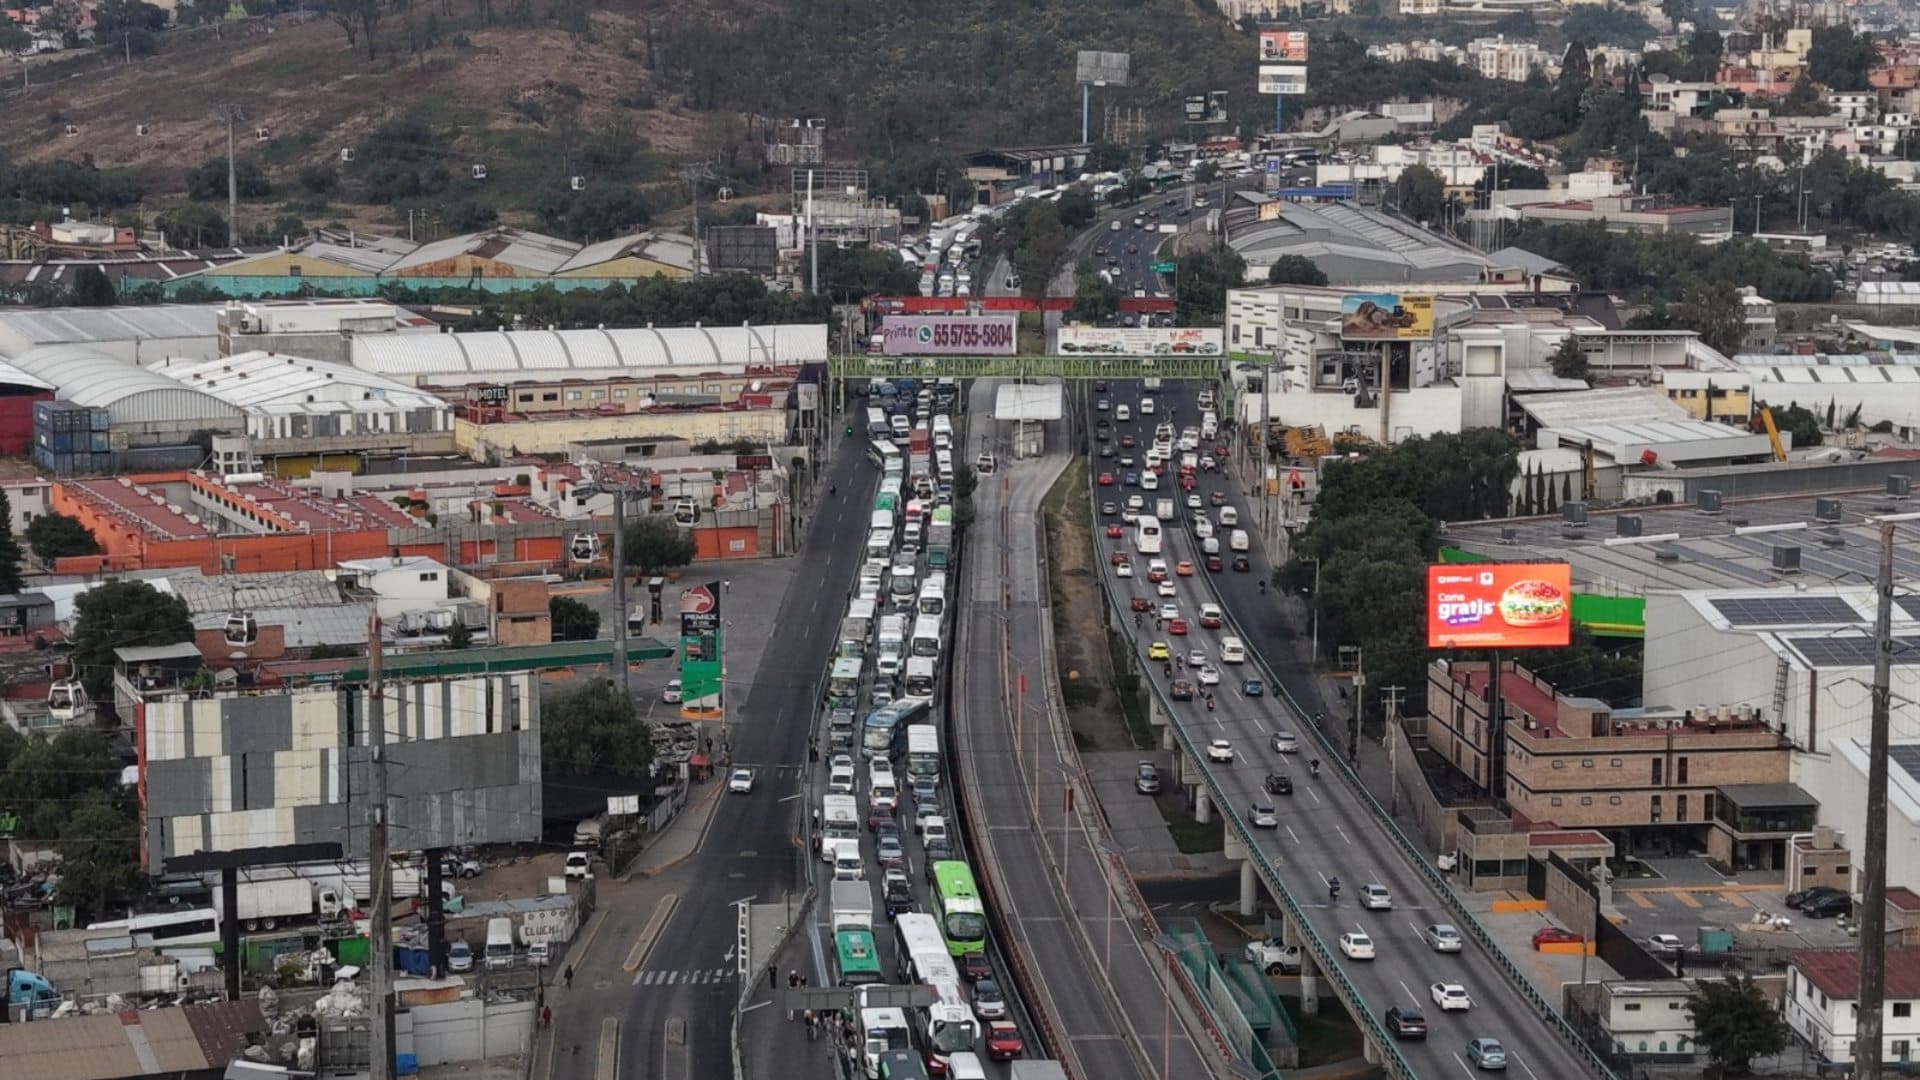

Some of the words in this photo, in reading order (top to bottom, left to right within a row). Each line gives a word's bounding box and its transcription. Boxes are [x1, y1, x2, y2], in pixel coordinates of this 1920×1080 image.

[884, 325, 917, 343] Printer
[950, 324, 1012, 346] 5755-5804
[479, 388, 507, 400] MOTEL
